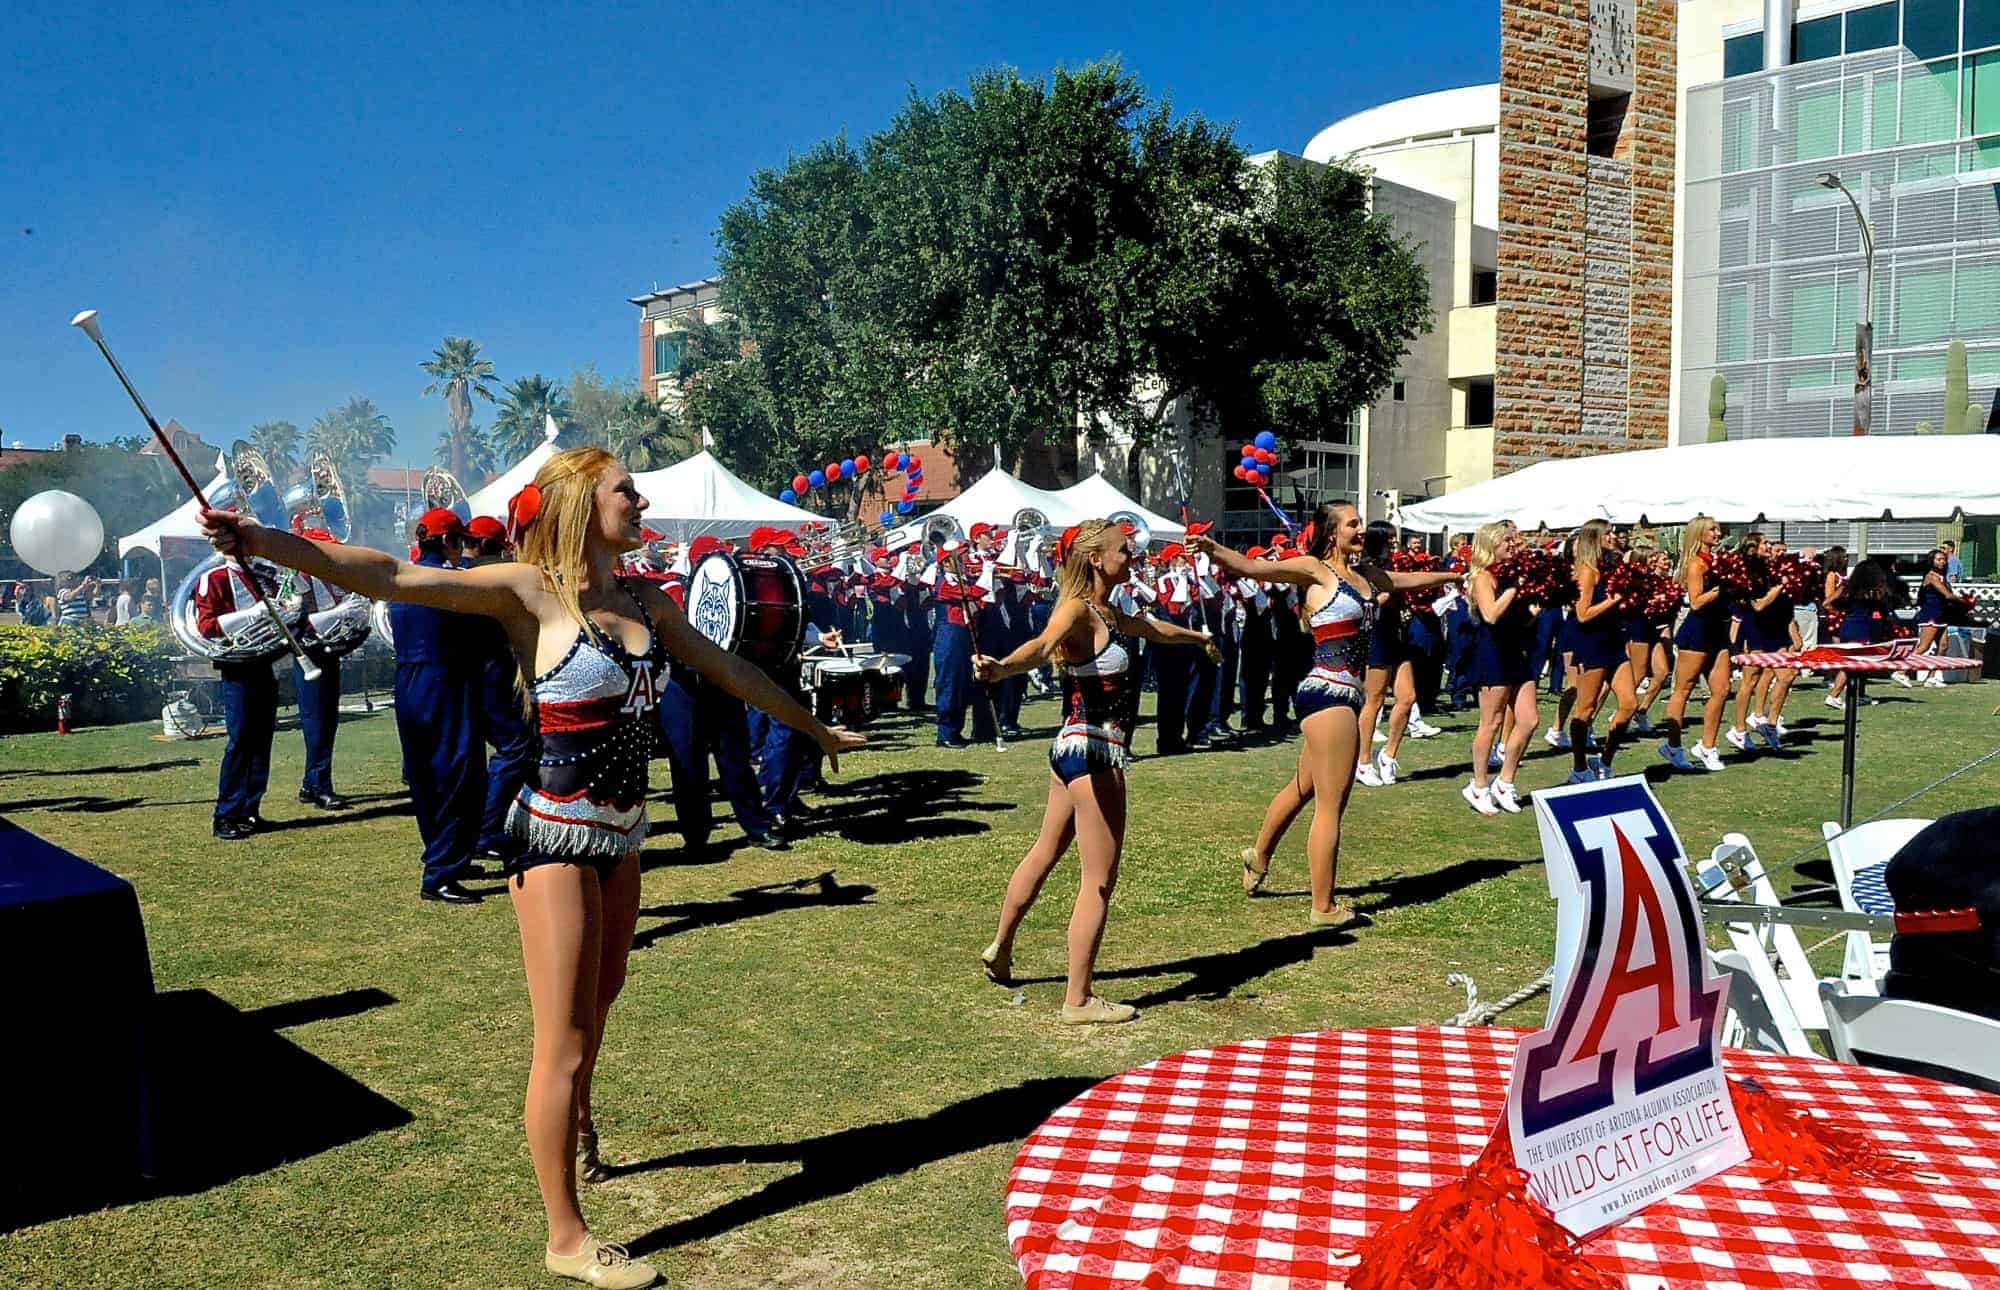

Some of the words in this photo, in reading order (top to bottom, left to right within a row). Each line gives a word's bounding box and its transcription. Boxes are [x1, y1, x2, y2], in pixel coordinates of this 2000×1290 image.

[620, 660, 654, 720] A
[1526, 1145, 1545, 1166] THE
[1545, 1126, 1594, 1159] UNIVERSITY
[1595, 1120, 1607, 1139] OF
[1609, 1107, 1642, 1134] ARIZONA
[1643, 1097, 1672, 1122] ALUMNI
[1533, 1134, 1639, 1206] WILDCAT
[1639, 1116, 1690, 1164] FOR
